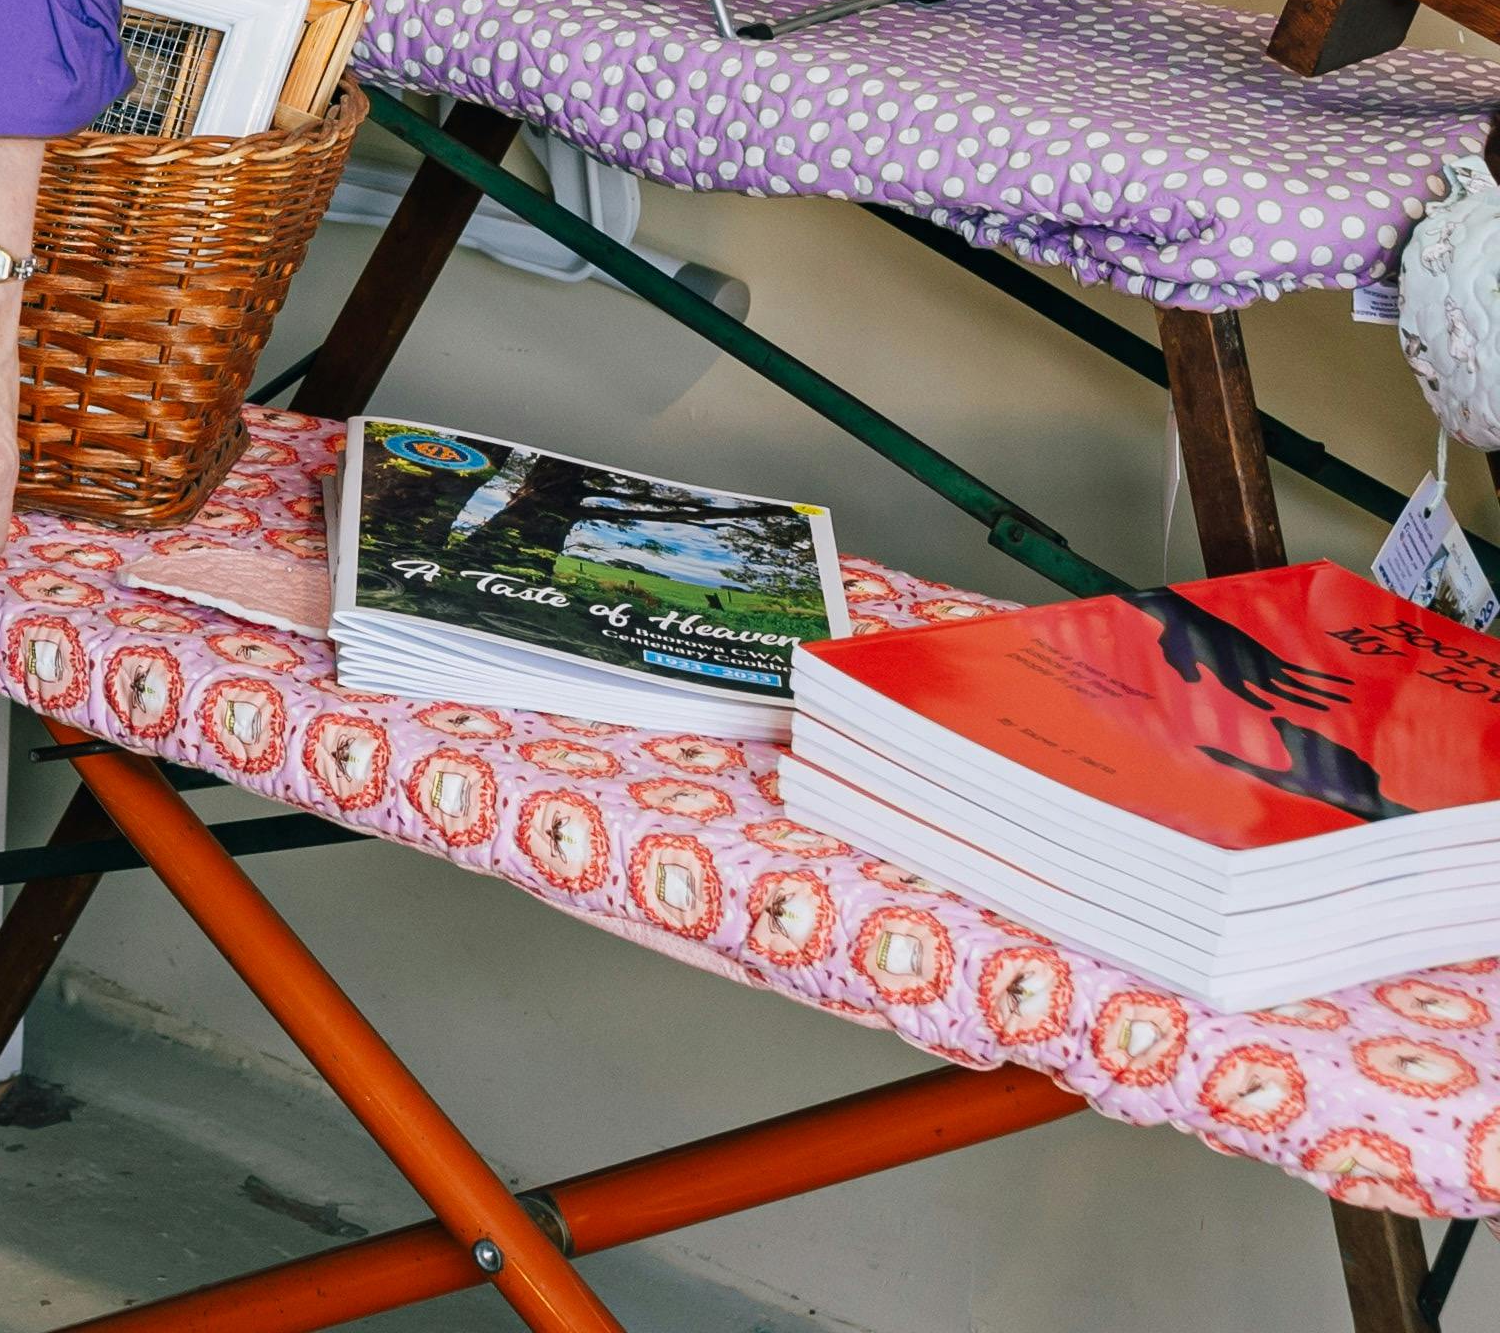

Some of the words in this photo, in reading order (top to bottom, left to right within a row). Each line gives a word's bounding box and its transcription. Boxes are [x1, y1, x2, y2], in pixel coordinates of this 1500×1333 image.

[391, 559, 441, 583] A
[460, 569, 571, 609] Taste
[589, 602, 633, 627] of
[648, 610, 802, 648] Heaven
[601, 628, 708, 660] Centenary
[635, 627, 726, 654] Boorowa
[729, 647, 785, 664] CWA
[1326, 625, 1408, 661] My
[656, 654, 698, 672] 1923
[721, 669, 773, 684] 2023
